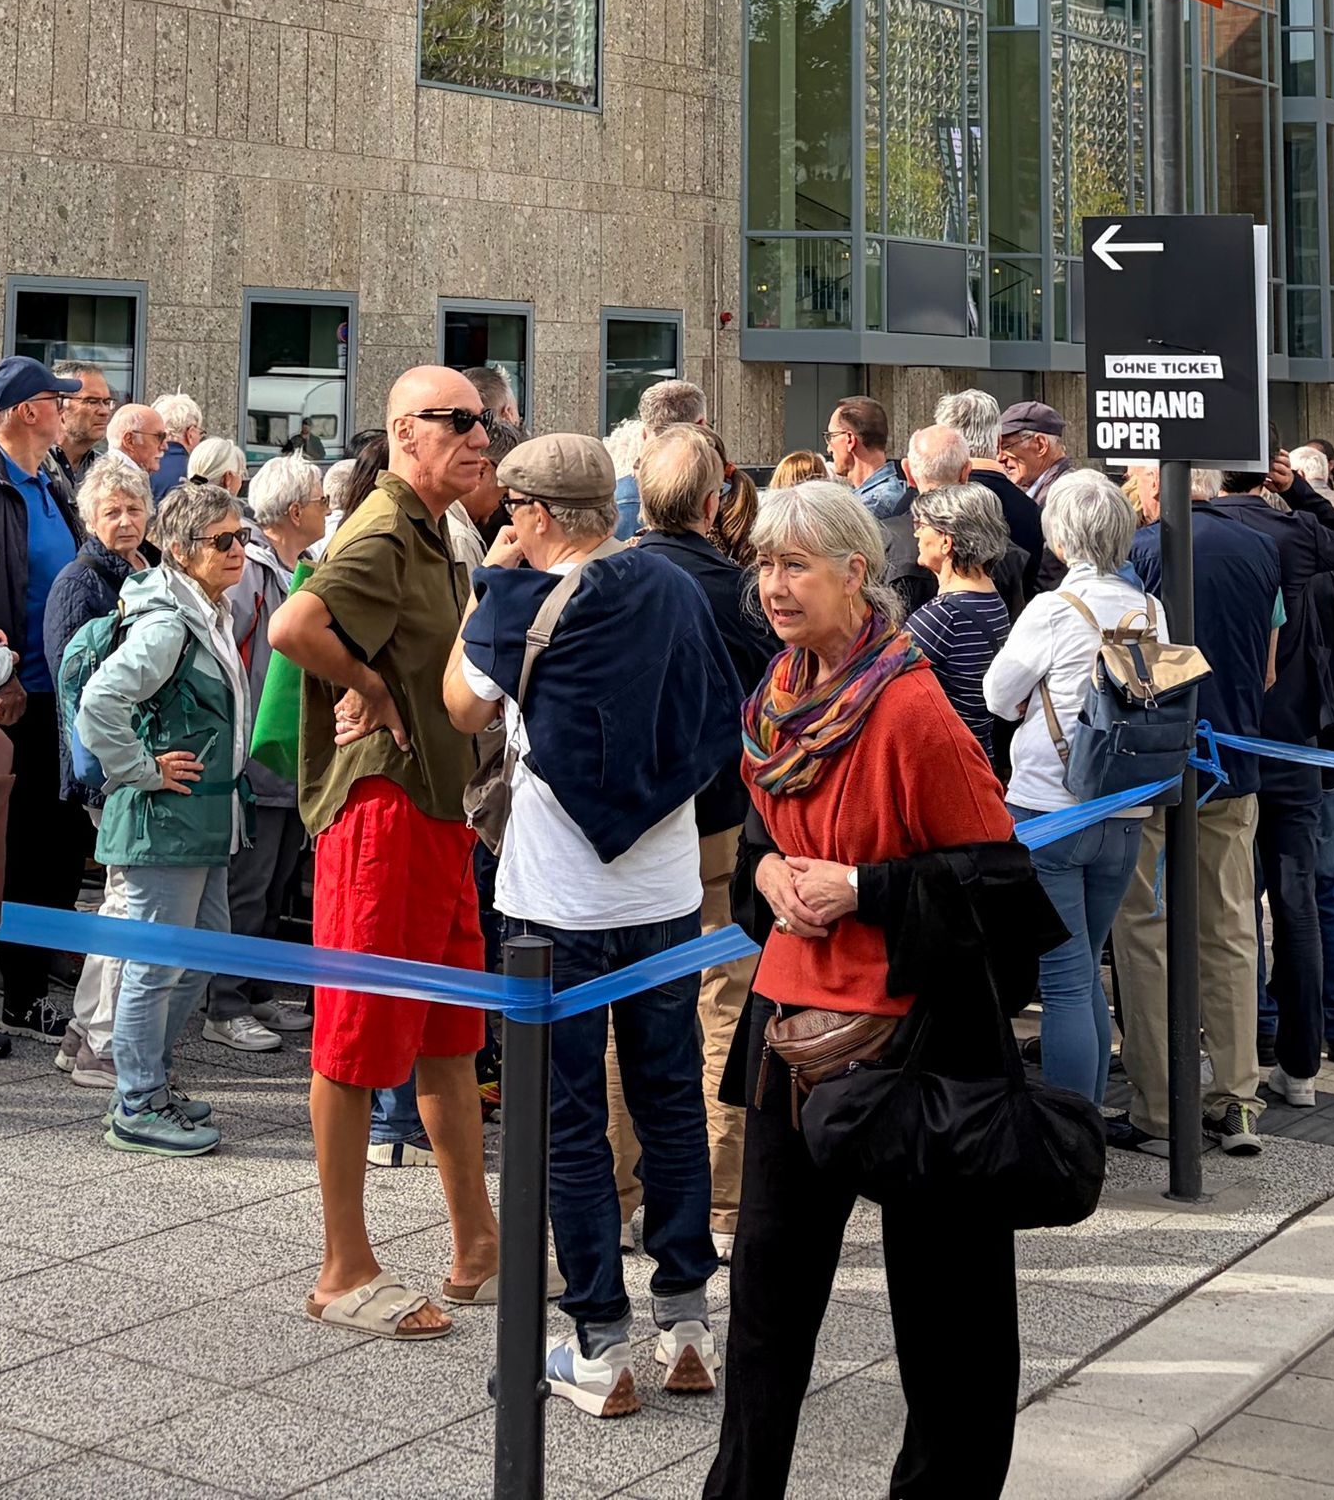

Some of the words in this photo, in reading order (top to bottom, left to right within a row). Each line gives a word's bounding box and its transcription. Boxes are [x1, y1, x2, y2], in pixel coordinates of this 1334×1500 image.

[1113, 363, 1157, 374] OHNE
[1161, 363, 1218, 374] TICKET
[1096, 390, 1205, 419] EINGANG
[1096, 422, 1161, 450] OPER
